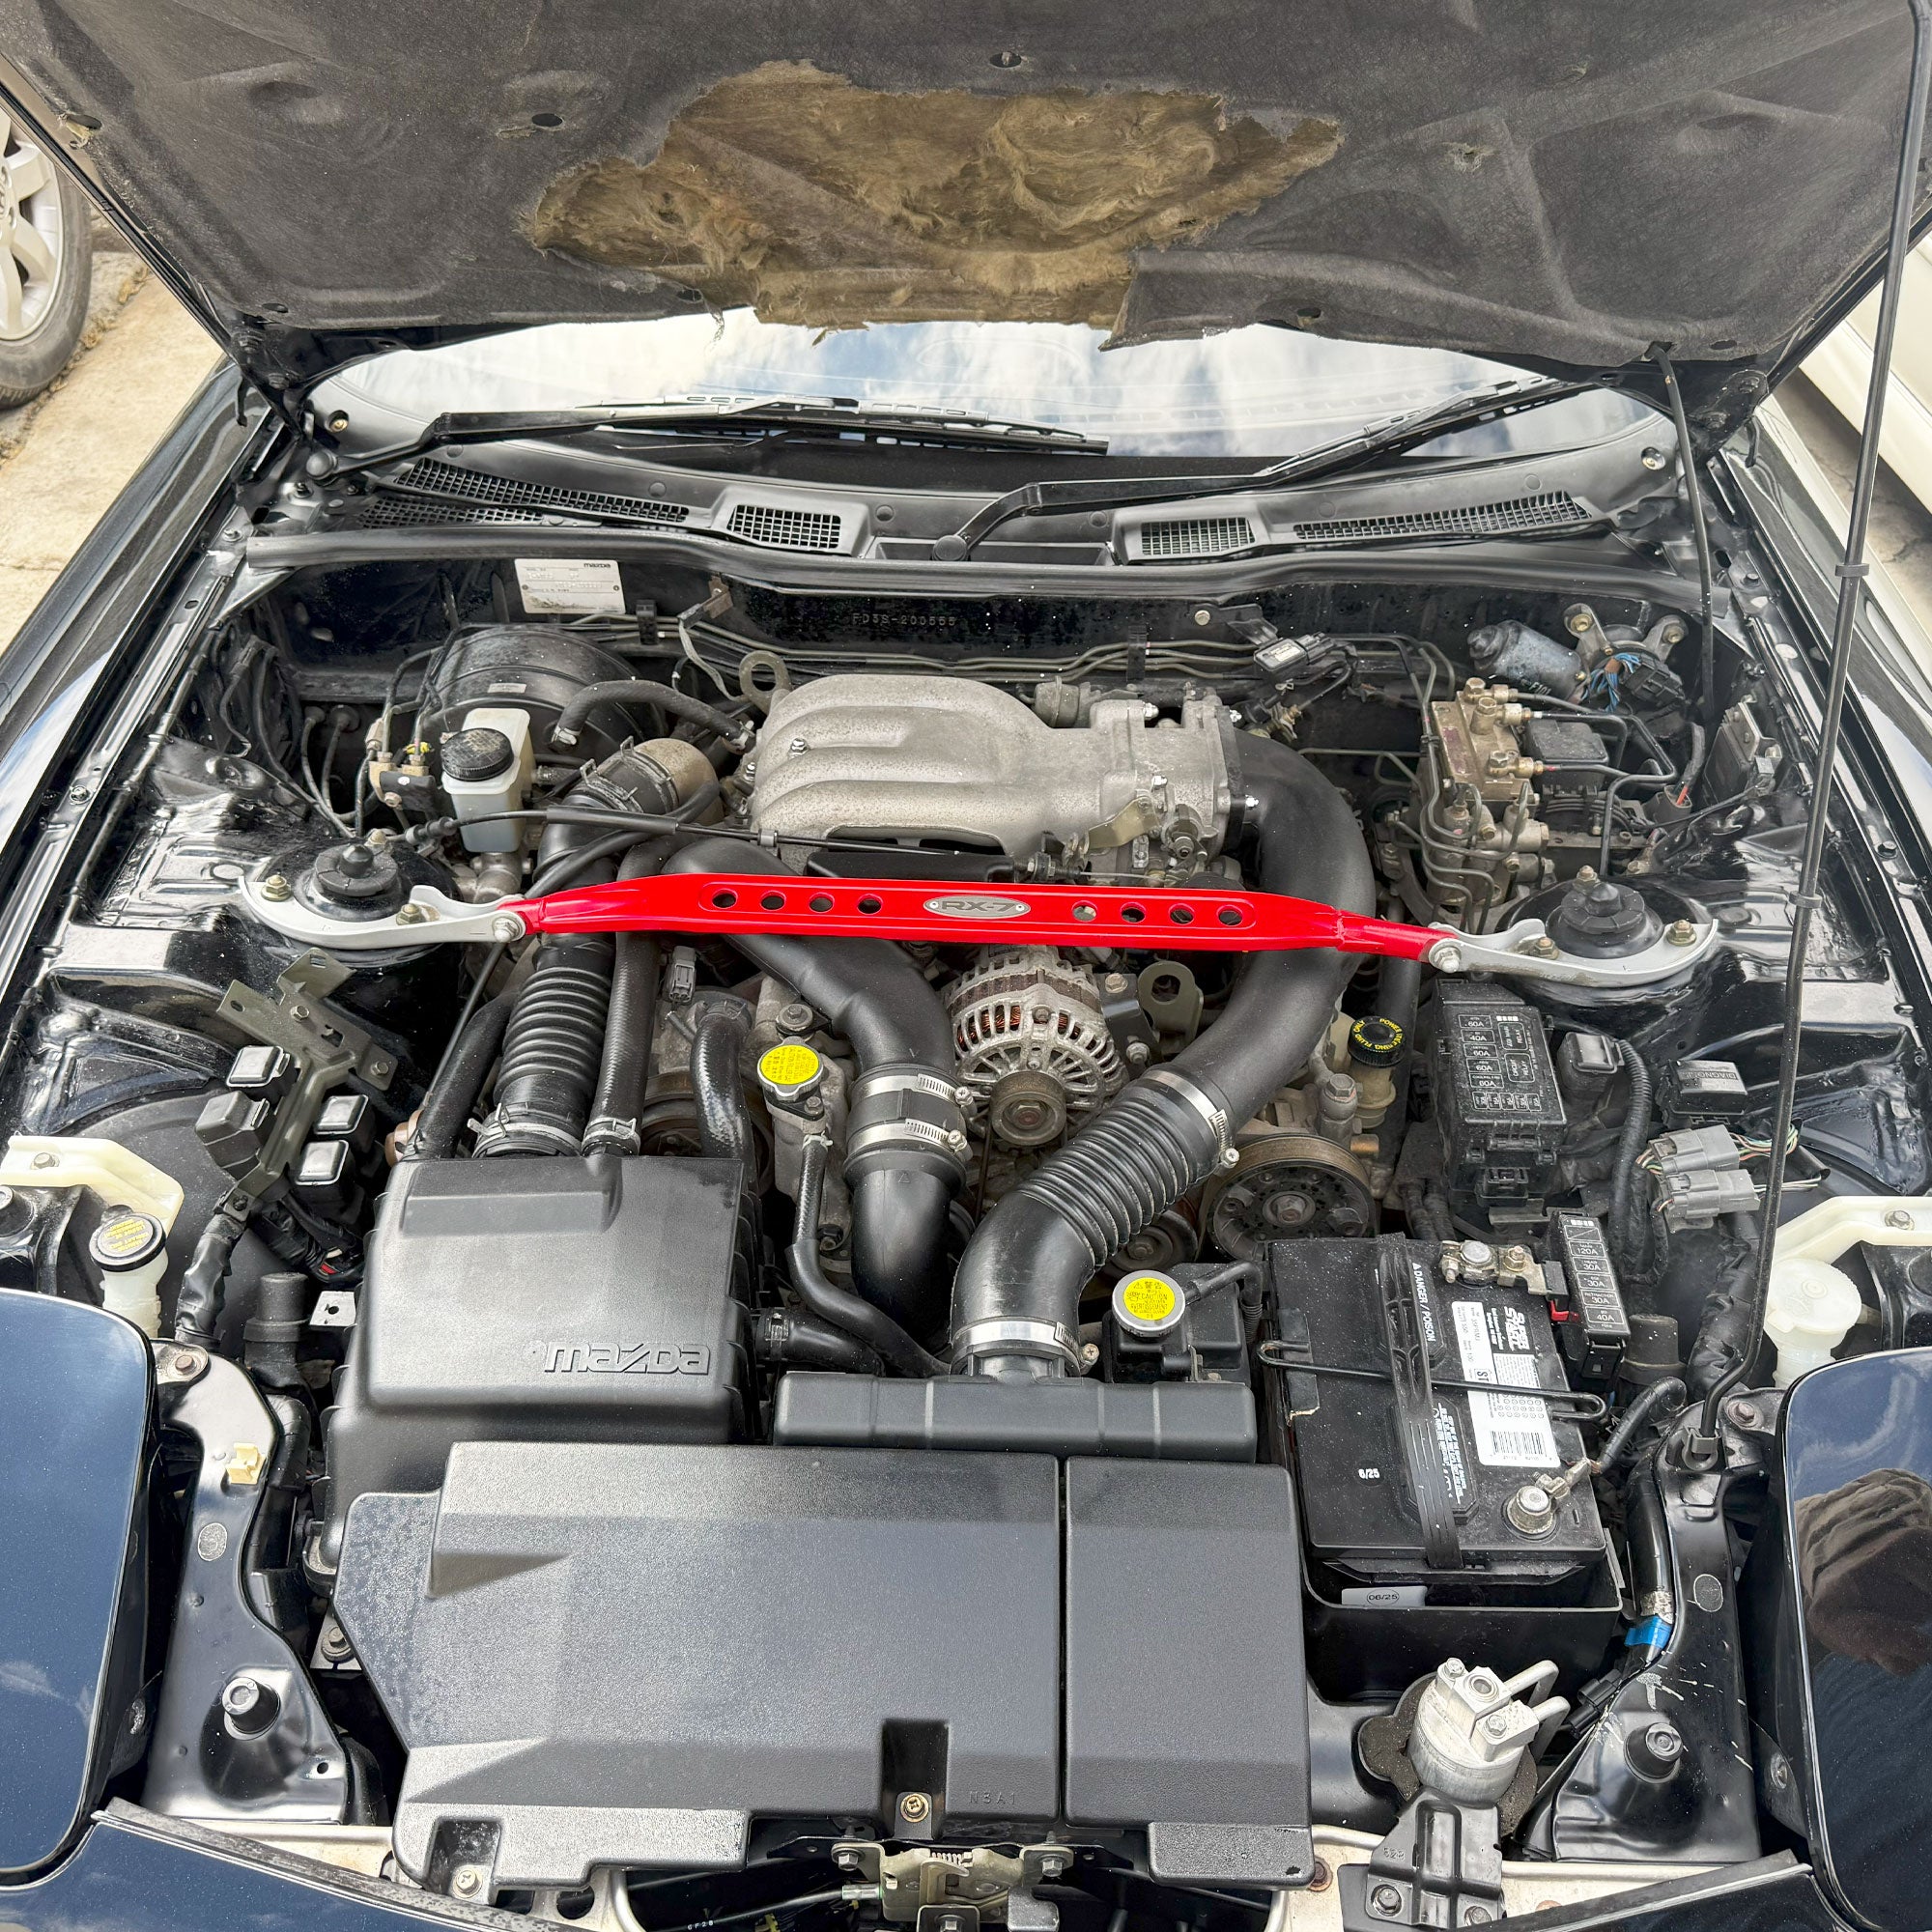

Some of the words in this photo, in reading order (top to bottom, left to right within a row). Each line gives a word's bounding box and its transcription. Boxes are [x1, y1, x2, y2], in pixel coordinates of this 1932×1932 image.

[942, 900, 1015, 912] RX-7
[1379, 1018, 1403, 1033] POWER
[1413, 1270, 1429, 1303] DANGER
[1422, 1311, 1437, 1342] POISON
[544, 1341, 711, 1375] mazda
